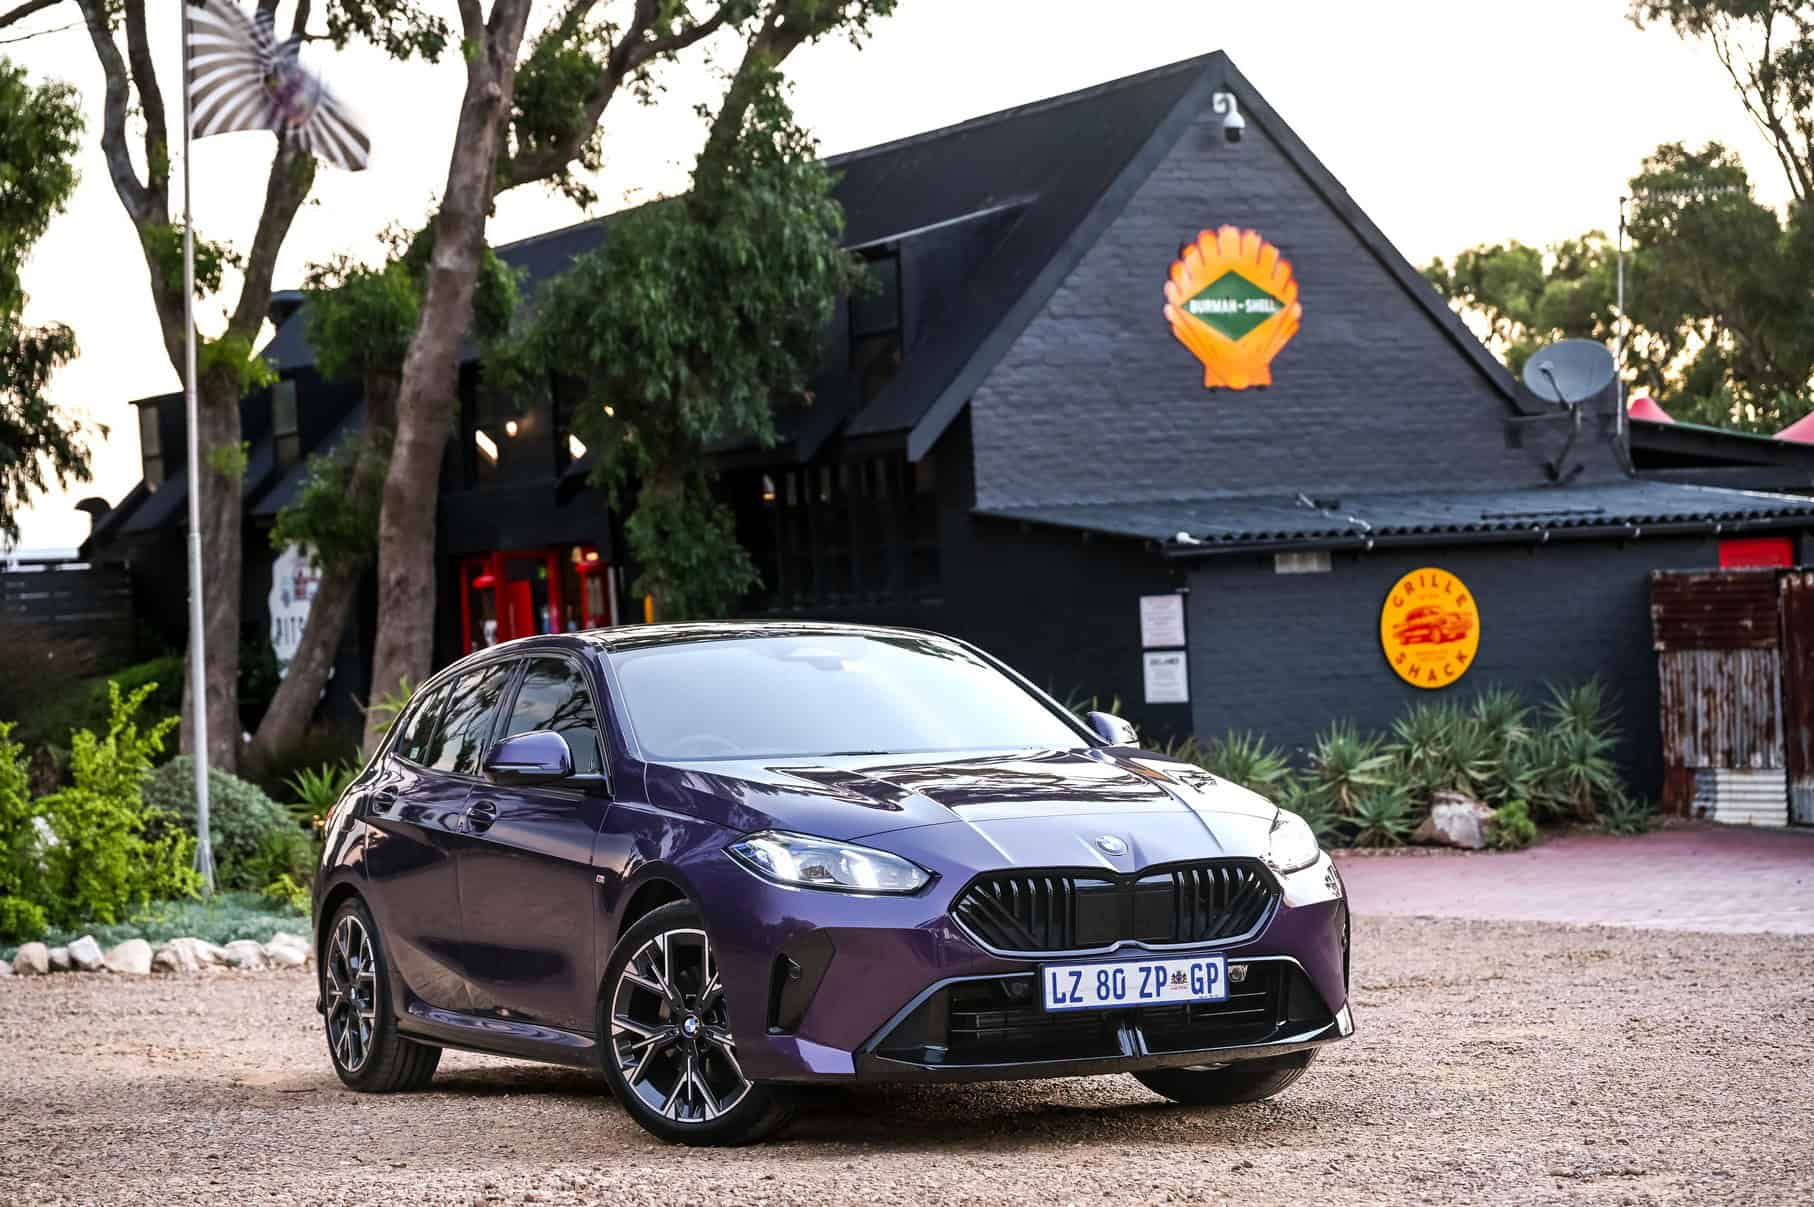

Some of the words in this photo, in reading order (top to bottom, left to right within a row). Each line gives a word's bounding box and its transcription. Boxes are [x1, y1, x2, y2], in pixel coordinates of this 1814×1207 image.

[1392, 574, 1467, 608] GRILLE
[1394, 650, 1468, 681] SHACK
[1051, 970, 1084, 1004] LZ
[1096, 968, 1126, 1001] 80
[1138, 965, 1168, 999] ZP
[1190, 962, 1219, 995] GP
